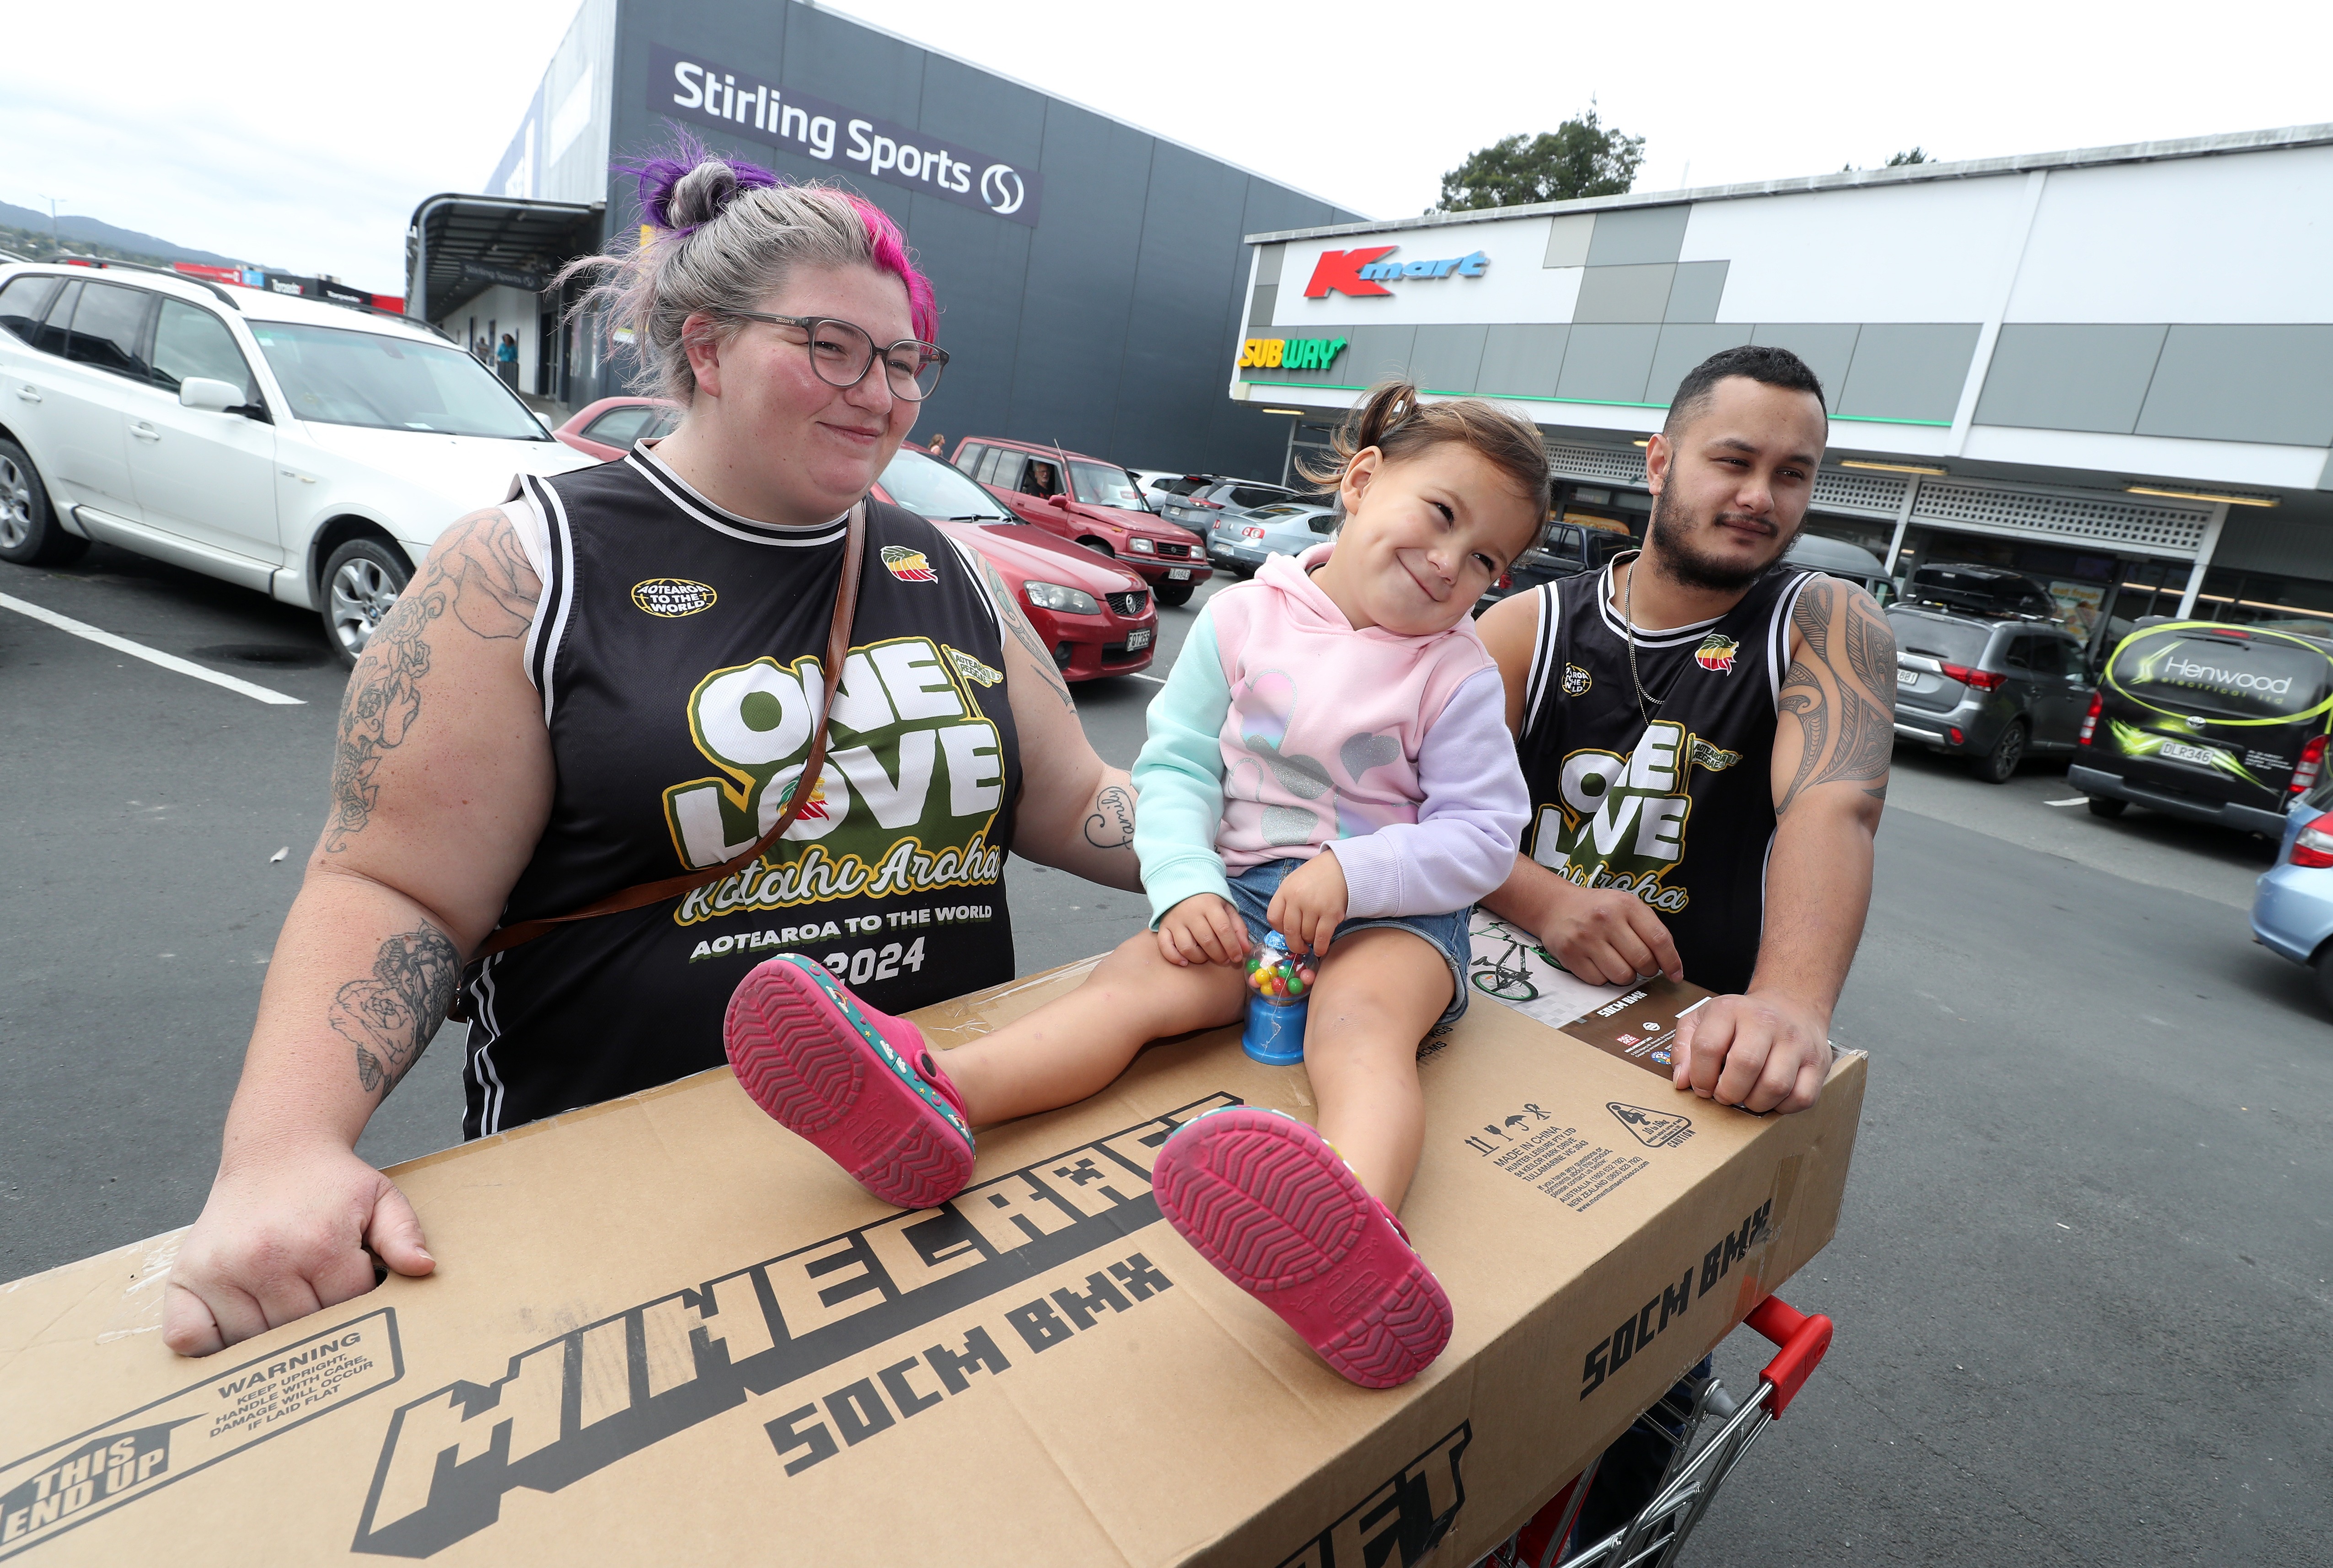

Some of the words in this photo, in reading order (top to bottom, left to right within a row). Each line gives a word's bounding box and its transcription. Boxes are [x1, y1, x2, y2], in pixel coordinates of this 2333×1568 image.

[673, 61, 836, 160] Stirling
[846, 118, 971, 194] Sports
[1303, 246, 1491, 298] Kmart
[1238, 336, 1347, 369] SUBWAY
[637, 585, 709, 594] AOTEAROA
[650, 595, 670, 603] TO
[672, 594, 699, 603] THE
[650, 600, 705, 612] WORLD
[2161, 677, 2247, 697] electrical
[2164, 656, 2292, 694] Henwood
[696, 641, 964, 765] ONE
[1562, 724, 1680, 813] OE
[1693, 751, 1720, 768] REGGAE
[2163, 744, 2211, 763] DLR346
[675, 723, 1002, 867] LOVE
[1533, 797, 1687, 869] LVE
[870, 837, 1000, 892] Aroha
[690, 921, 842, 962] AOTEAROA
[845, 915, 884, 936] TO
[886, 908, 931, 930] THE
[935, 905, 992, 923] WORLD
[825, 936, 926, 985] 2024
[1621, 990, 1647, 1004] BMX
[1427, 1026, 1453, 1038] KGS
[1493, 1148, 1524, 1167] MADE
[1520, 1142, 1534, 1151] IN
[1531, 1126, 1562, 1144] CHINA
[1652, 1119, 1670, 1128] 16kg
[1667, 1129, 1696, 1148] CAUTION
[1505, 1155, 1532, 1172] HUNTER
[1529, 1140, 1555, 1157] LEISURE
[1552, 1134, 1565, 1143] PTY
[1563, 1128, 1577, 1136] LTD
[1522, 1157, 1545, 1174] KEILOR
[1542, 1148, 1560, 1160] PARK
[1557, 1137, 1577, 1150] DRIVE
[1522, 1155, 1566, 1182] TULLAMARINE
[1562, 1148, 1576, 1156] VIC
[1573, 1140, 1589, 1150] 3043
[1543, 1180, 1554, 1188] you
[1551, 1172, 1566, 1183] have
[1565, 1165, 1576, 1174] any
[1574, 1151, 1598, 1167] questions
[1544, 1176, 1571, 1194] comments
[1571, 1166, 1585, 1177] about
[1582, 1160, 1594, 1169] this
[1550, 1185, 1569, 1199] please
[1567, 1172, 1587, 1187] contact
[1559, 1180, 1592, 1203] AUSTRALIA
[1604, 1164, 1614, 1173] 632
[1611, 1156, 1627, 1166] 792)
[1567, 1196, 1583, 1208] NEW
[1581, 1179, 1608, 1199] ZEALAND
[1606, 1169, 1622, 1182] (0800
[1619, 1164, 1631, 1172] 623
[1627, 1156, 1643, 1165] 792)
[1576, 1161, 1650, 1213] www.momentumservicesco.com
[1697, 1198, 1772, 1299] BMX
[351, 1091, 1244, 1559] MINECRAF
[1005, 1252, 1176, 1354] BMX
[218, 1333, 361, 1398] WARNING
[237, 1383, 277, 1405] KEEP
[281, 1353, 348, 1386] UPRIGHT,
[210, 1402, 277, 1438] DAMAGE
[281, 1387, 318, 1405] WILL
[321, 1361, 373, 1388] OCCUR
[216, 1391, 278, 1425] HANDLE
[282, 1375, 320, 1394] WITH
[324, 1355, 367, 1377] CARE,
[248, 1419, 262, 1431] IF
[266, 1403, 300, 1423] LAID
[305, 1384, 341, 1405] FLAT
[33, 1436, 135, 1498] THIS
[2, 1479, 94, 1542] END
[106, 1448, 165, 1495] UP
